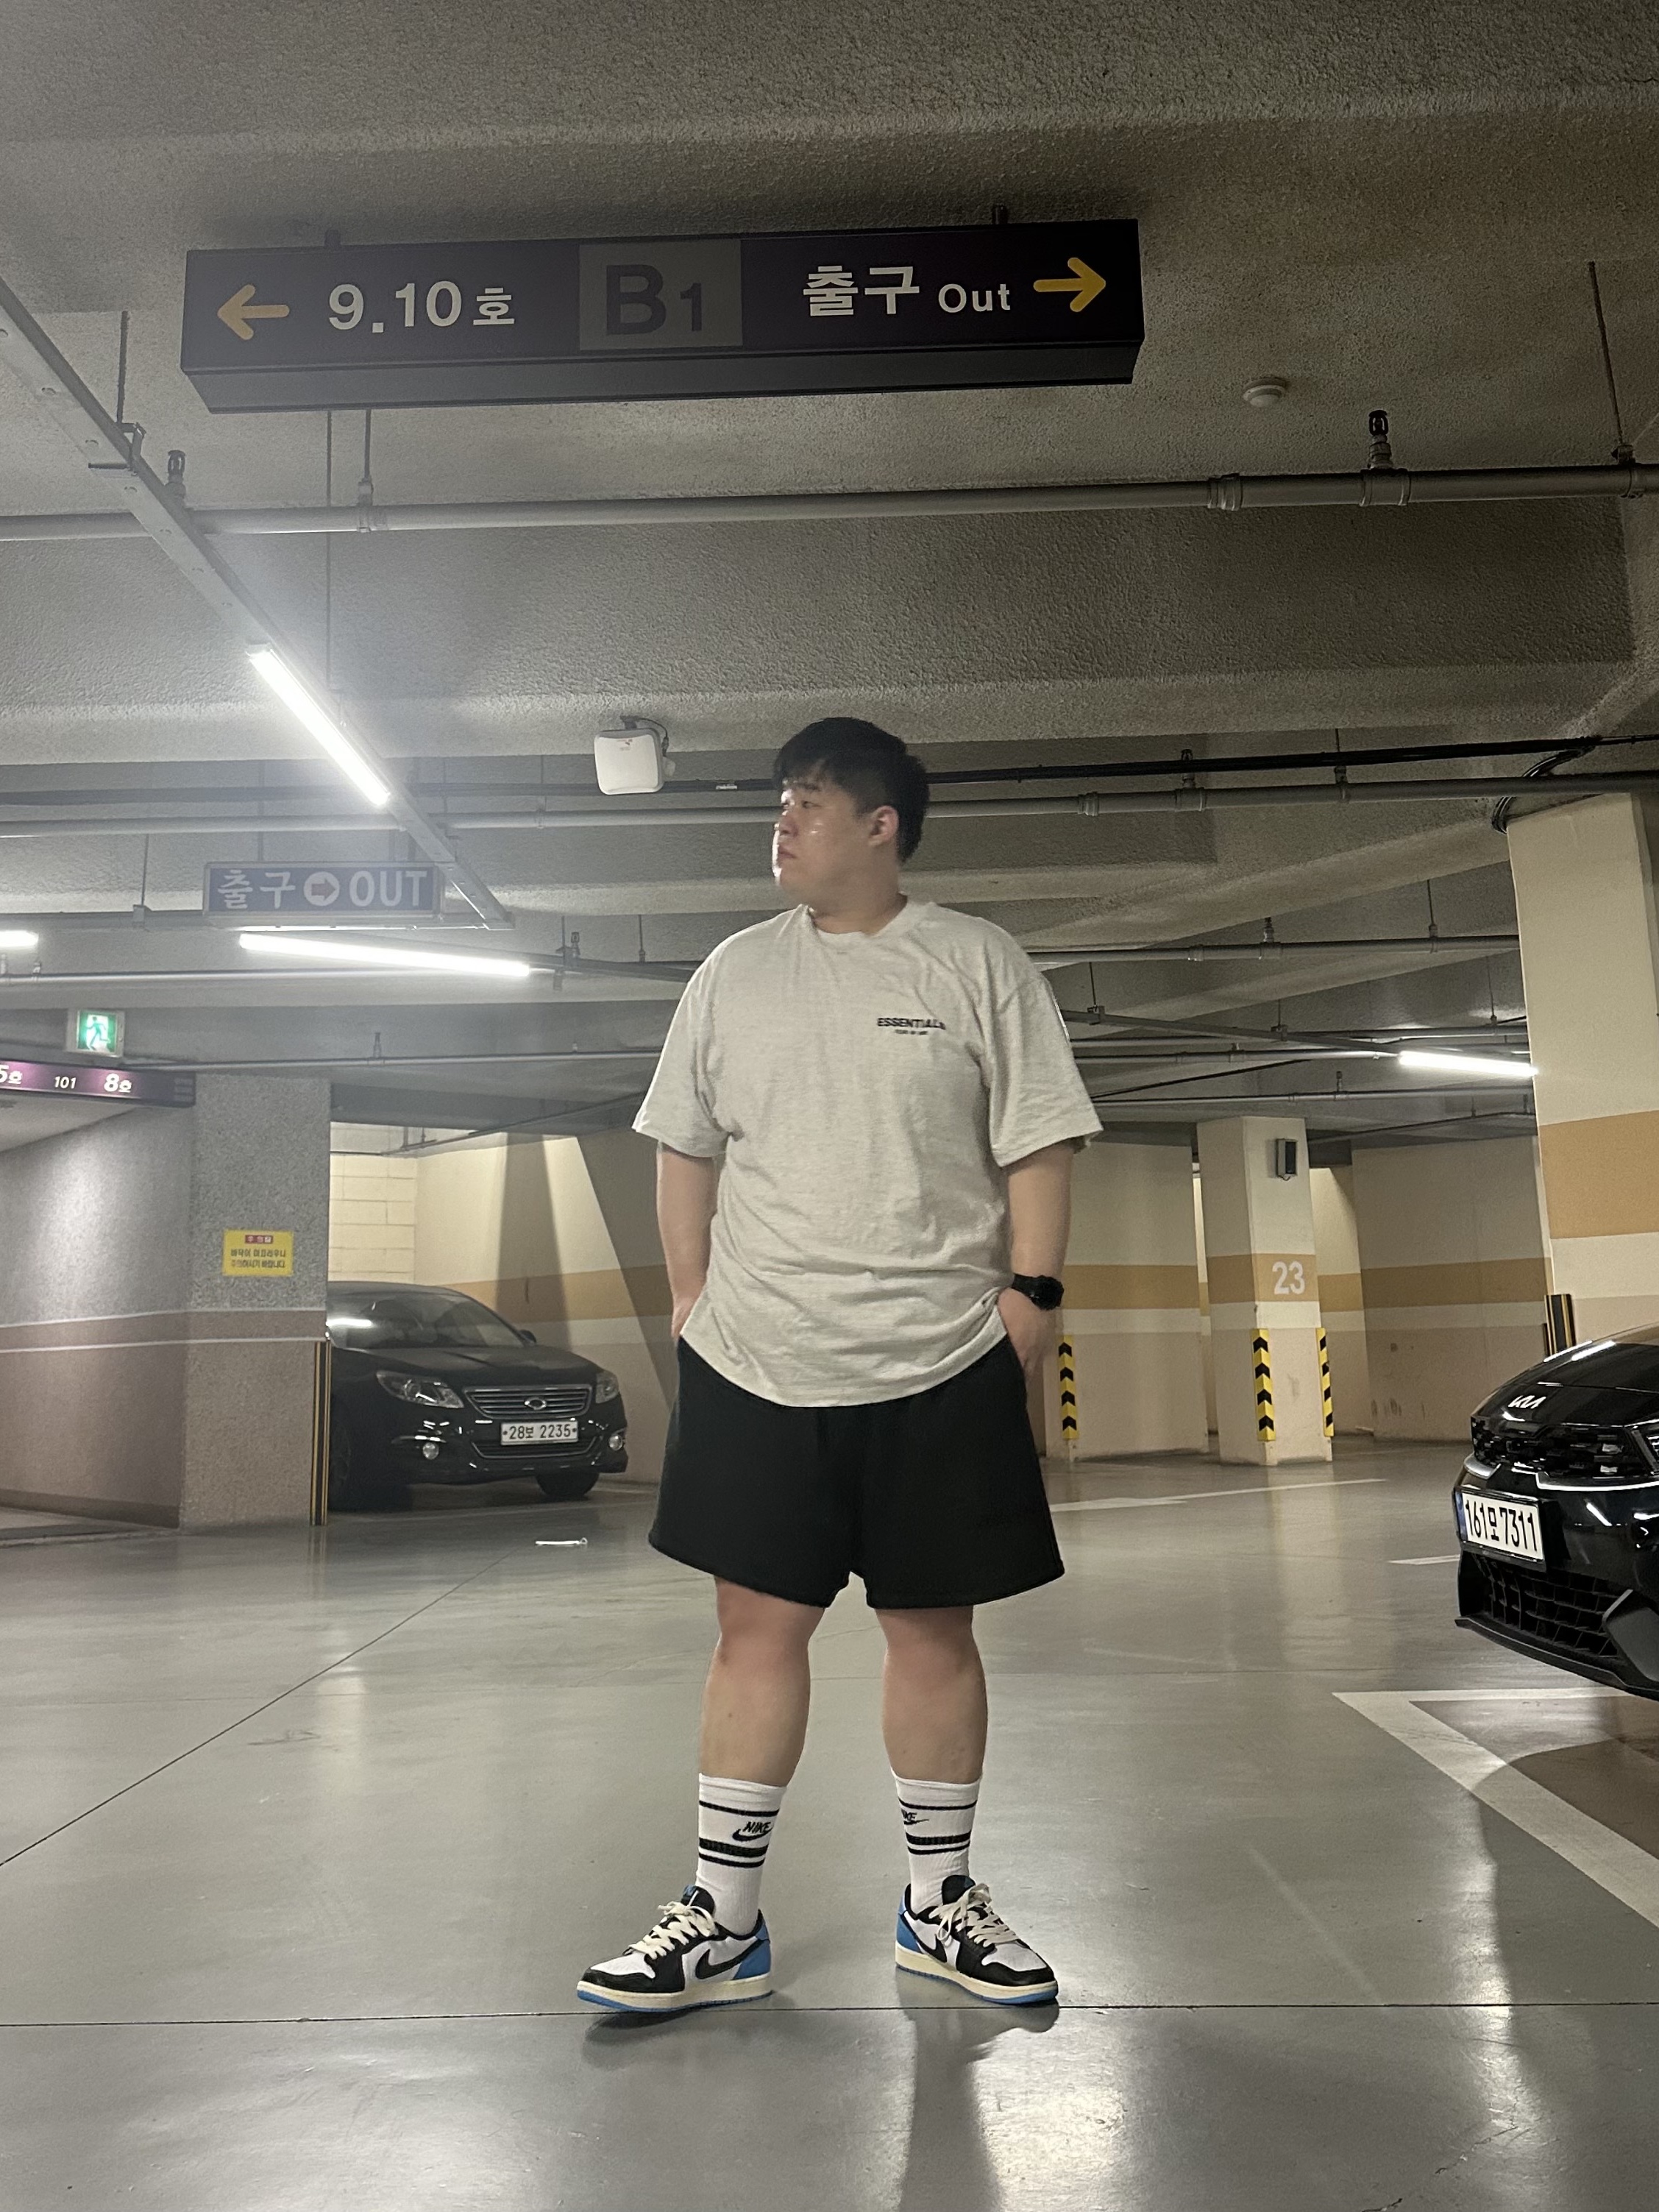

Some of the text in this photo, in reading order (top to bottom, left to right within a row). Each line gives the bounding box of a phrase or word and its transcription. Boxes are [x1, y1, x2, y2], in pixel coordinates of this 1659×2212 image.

[328, 280, 514, 333] 9.10호
[606, 263, 702, 335] B1
[803, 265, 1011, 316] 출구 Out
[217, 869, 427, 909] 출구 OUT
[54, 1076, 77, 1089] 101
[1272, 1261, 1306, 1294] 23
[539, 1424, 571, 1439] 2235
[742, 1821, 772, 1834] NIKE
